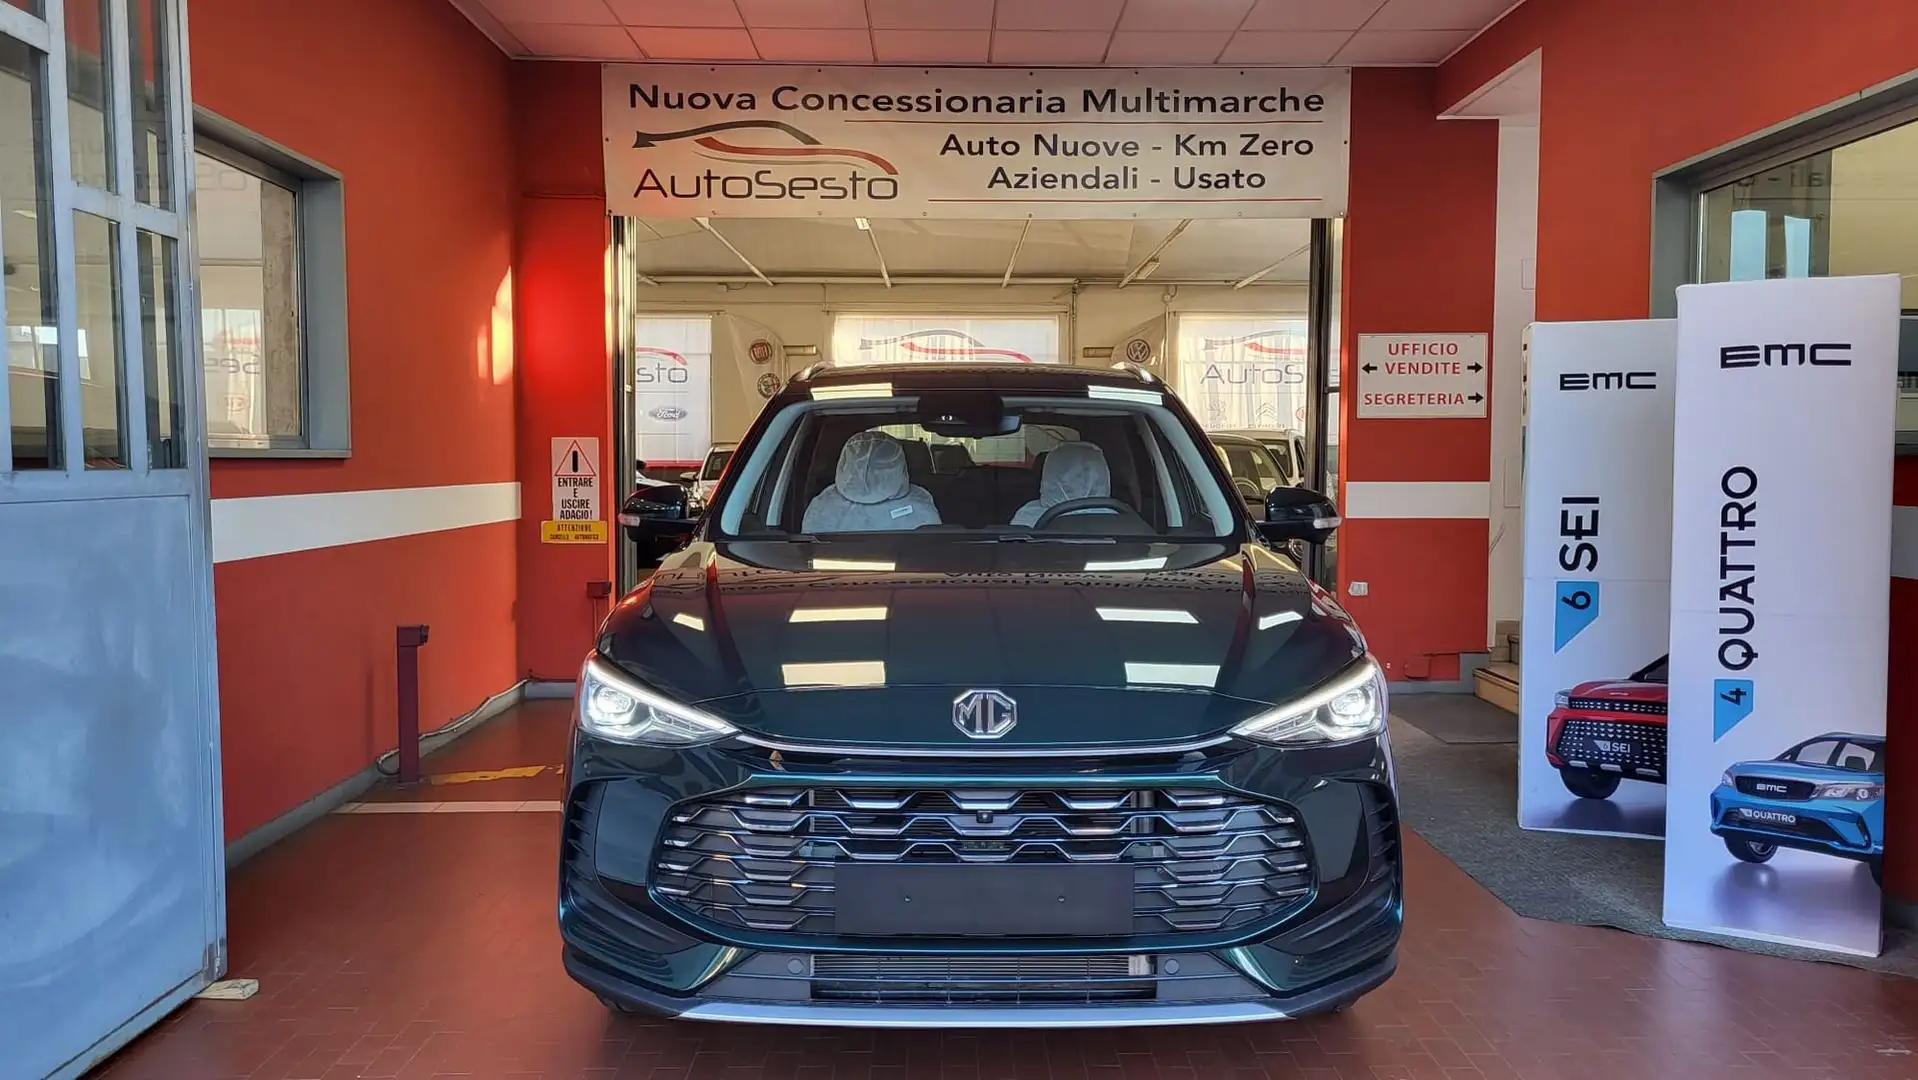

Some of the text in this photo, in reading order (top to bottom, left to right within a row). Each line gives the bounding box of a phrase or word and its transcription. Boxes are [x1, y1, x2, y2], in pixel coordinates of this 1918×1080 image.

[629, 83, 1325, 114] Nuova Concessionaria Multimarche
[939, 133, 1021, 156] Auto
[1034, 133, 1139, 157] Nuove
[1175, 133, 1227, 156] Km
[1239, 133, 1314, 156] Zero
[633, 168, 899, 200] AutoSesto
[987, 165, 1138, 190] Aziendali
[1174, 166, 1266, 190] Usato
[1388, 343, 1459, 356] UFFICIO
[1720, 343, 1852, 369] EMC
[1385, 362, 1461, 375] VENDITE
[1559, 372, 1657, 391] EMC
[1364, 393, 1465, 406] SEGRETERIA
[557, 477, 594, 488] ENTRARE
[573, 488, 578, 498] E
[561, 499, 590, 509] USCIRE
[560, 510, 593, 520] ADAGIO!
[1558, 497, 1600, 610] 6 SEI
[1718, 466, 1758, 706] 4 QUATTRO
[958, 693, 1012, 734] MG
[1611, 743, 1631, 753] SEI
[1753, 810, 1796, 823] QUATTRO
